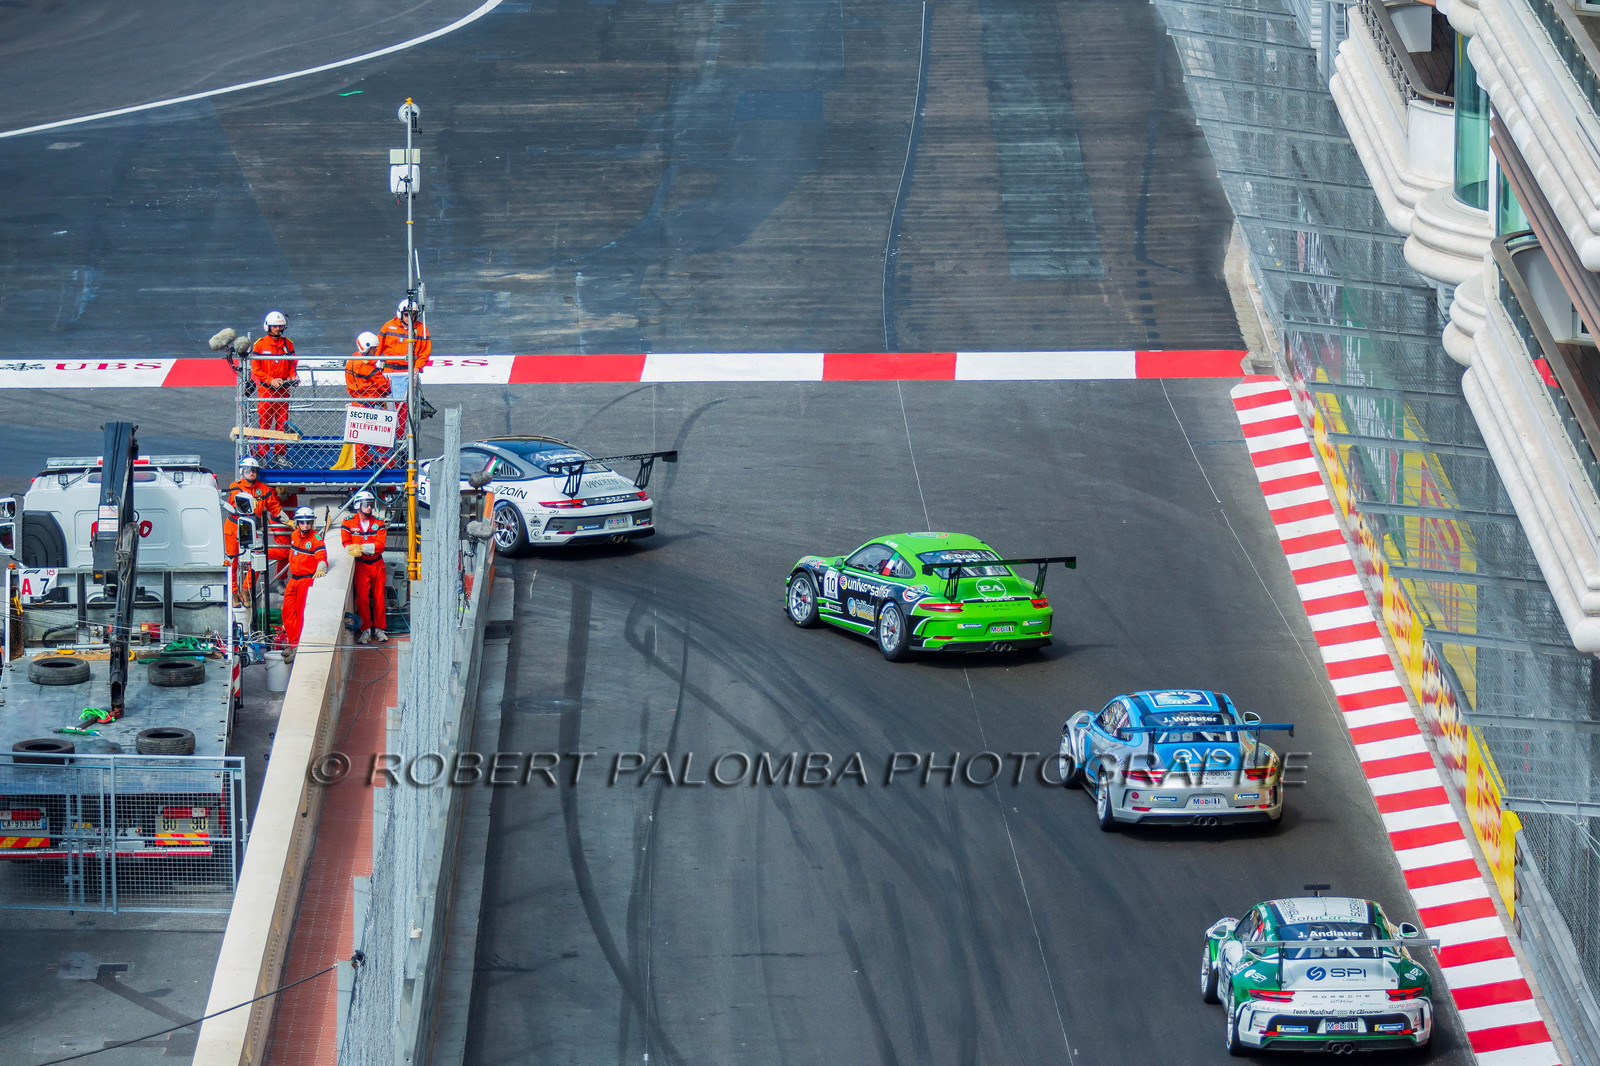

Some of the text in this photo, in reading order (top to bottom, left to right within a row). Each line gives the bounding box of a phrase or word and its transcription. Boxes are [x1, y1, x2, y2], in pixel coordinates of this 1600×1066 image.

[56, 362, 162, 371] UBS
[350, 411, 393, 423] SECTEUR 10
[350, 421, 392, 433] INTERVENTION
[349, 430, 359, 439] 10
[500, 485, 528, 500] zain
[21, 577, 50, 596] A 7
[826, 576, 836, 593] 10
[1309, 930, 1363, 938] Andlauer
[1330, 968, 1367, 978] SPI
[1326, 1022, 1357, 1031] Mobil 1
